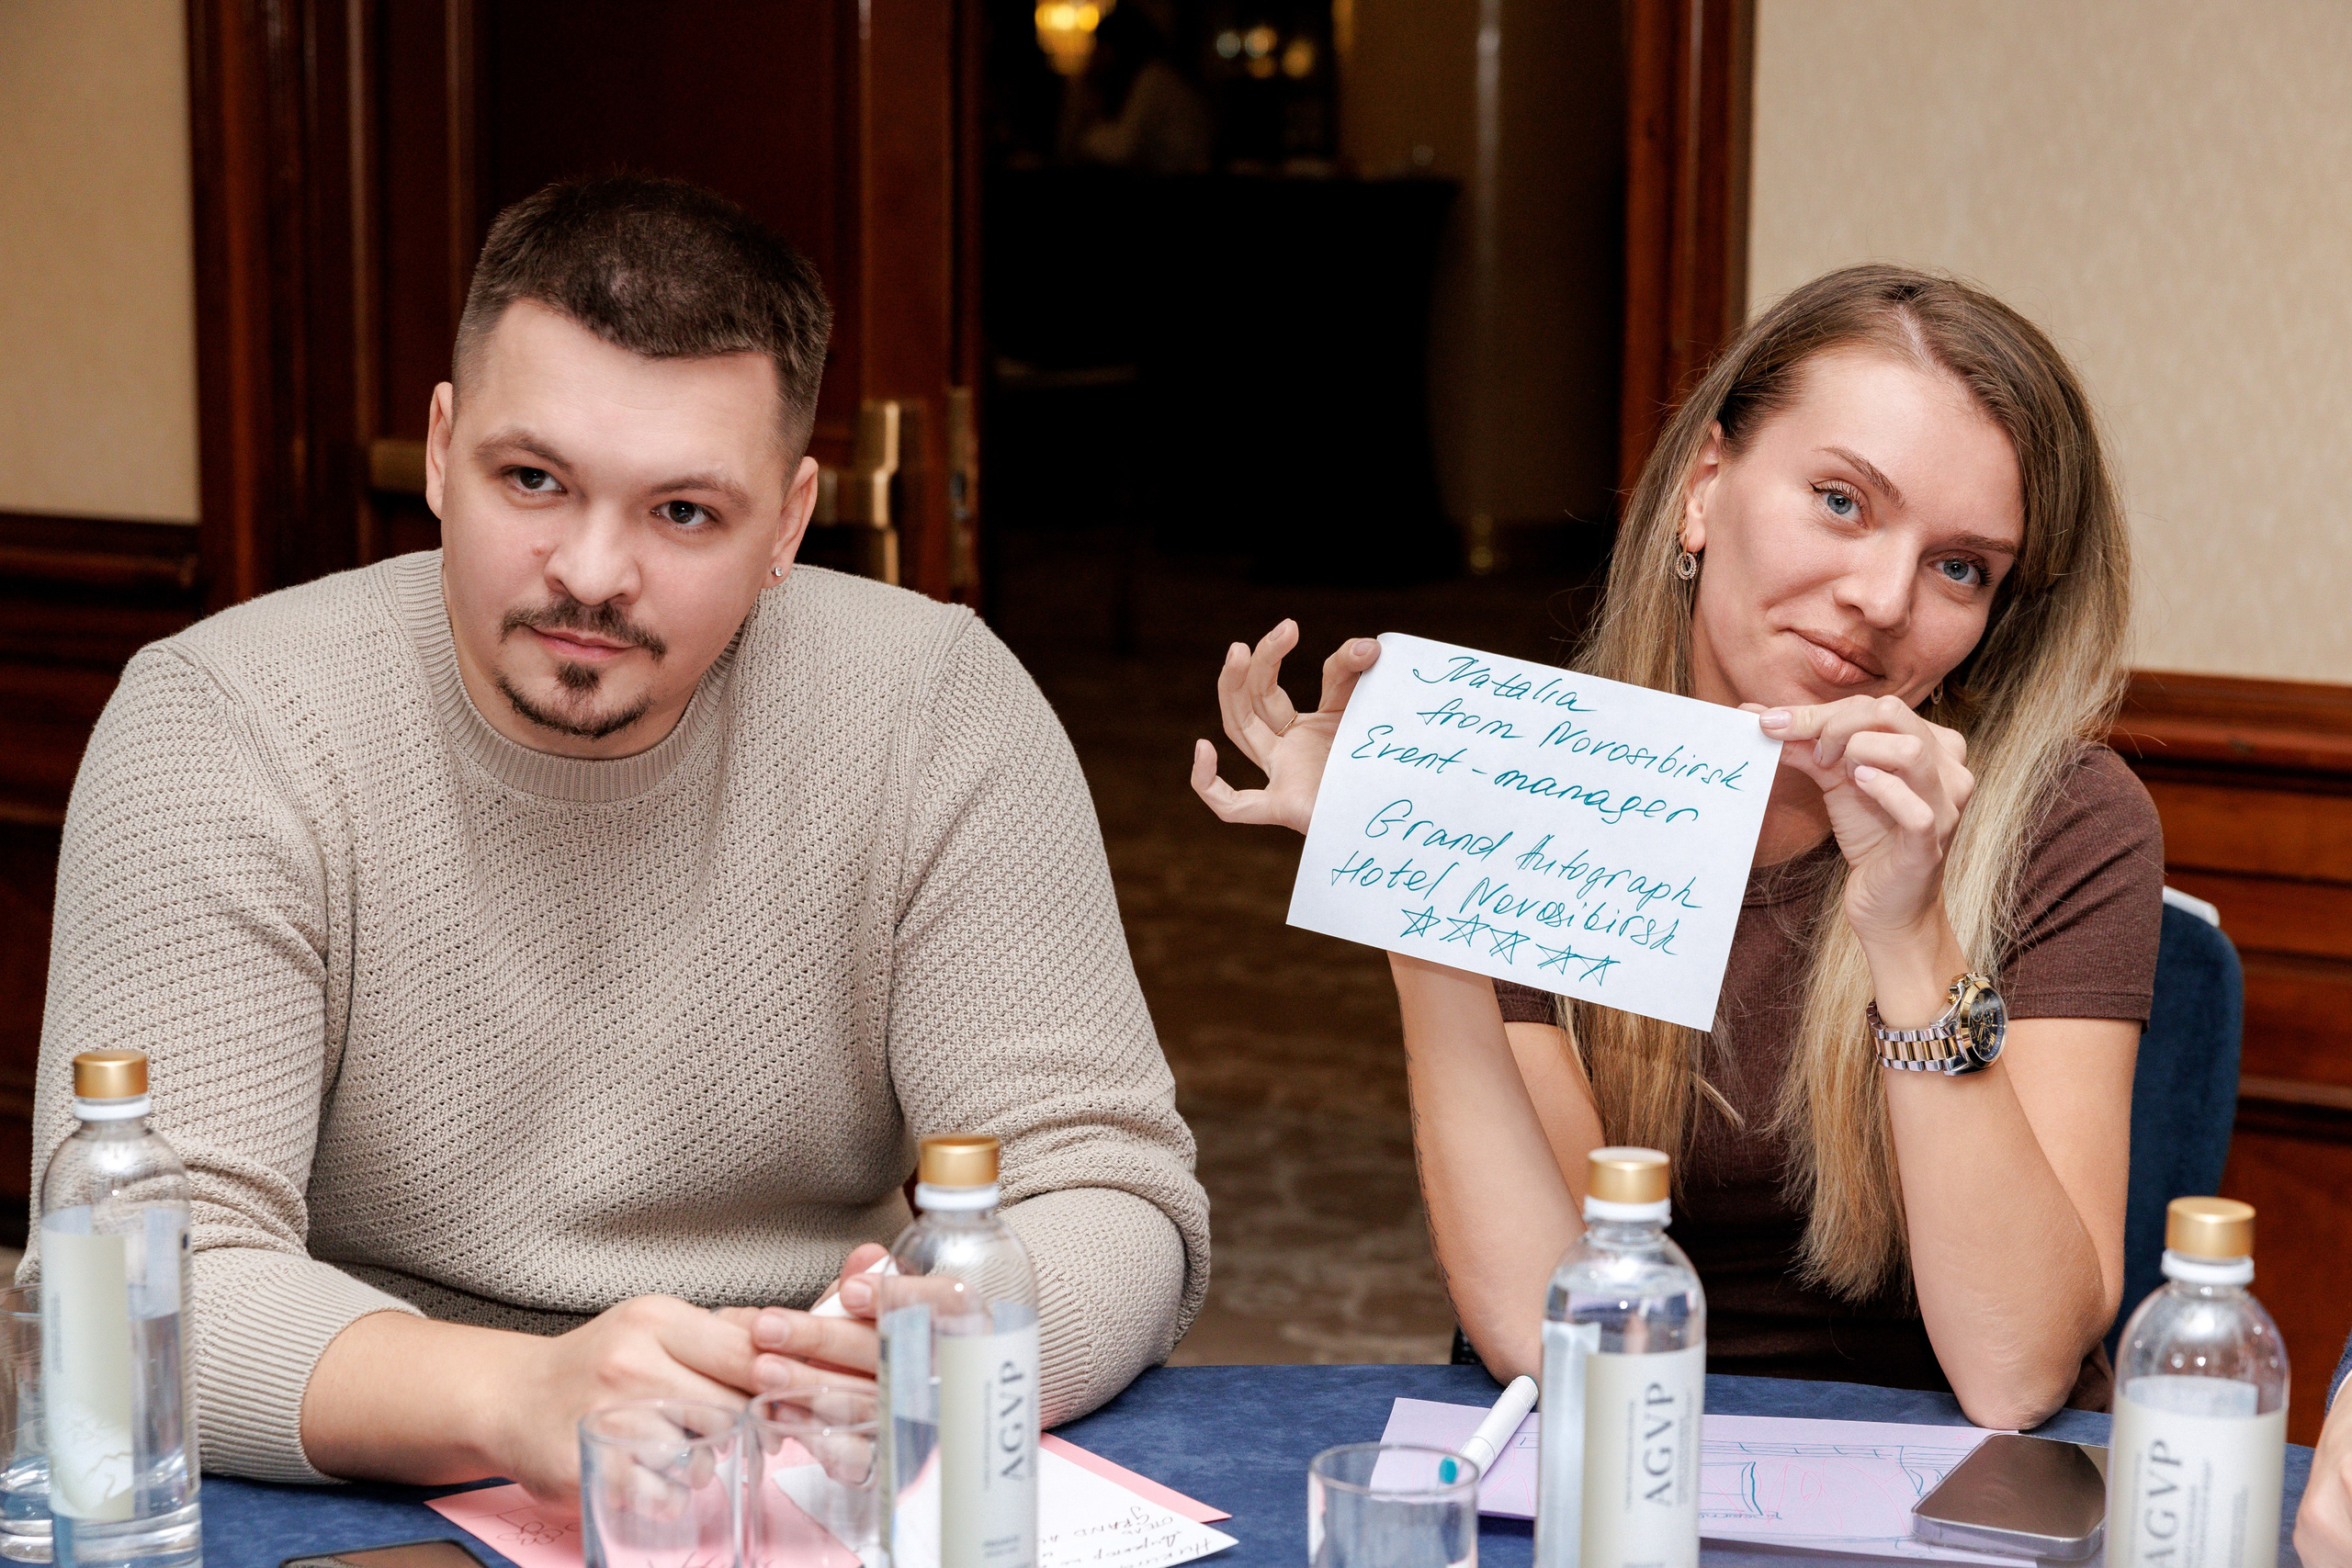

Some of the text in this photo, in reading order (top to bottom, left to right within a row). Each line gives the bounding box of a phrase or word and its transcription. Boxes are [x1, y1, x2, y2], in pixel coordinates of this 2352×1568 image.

[1413, 657, 1597, 713] Natalia
[1417, 698, 1749, 792] from Novosibirsk
[1332, 850, 1679, 957] Hotel Novosibirsk
[1365, 799, 1703, 913] Grand Autograph
[998, 1360, 1024, 1482] AGVP
[1643, 1382, 1675, 1507] AGVP
